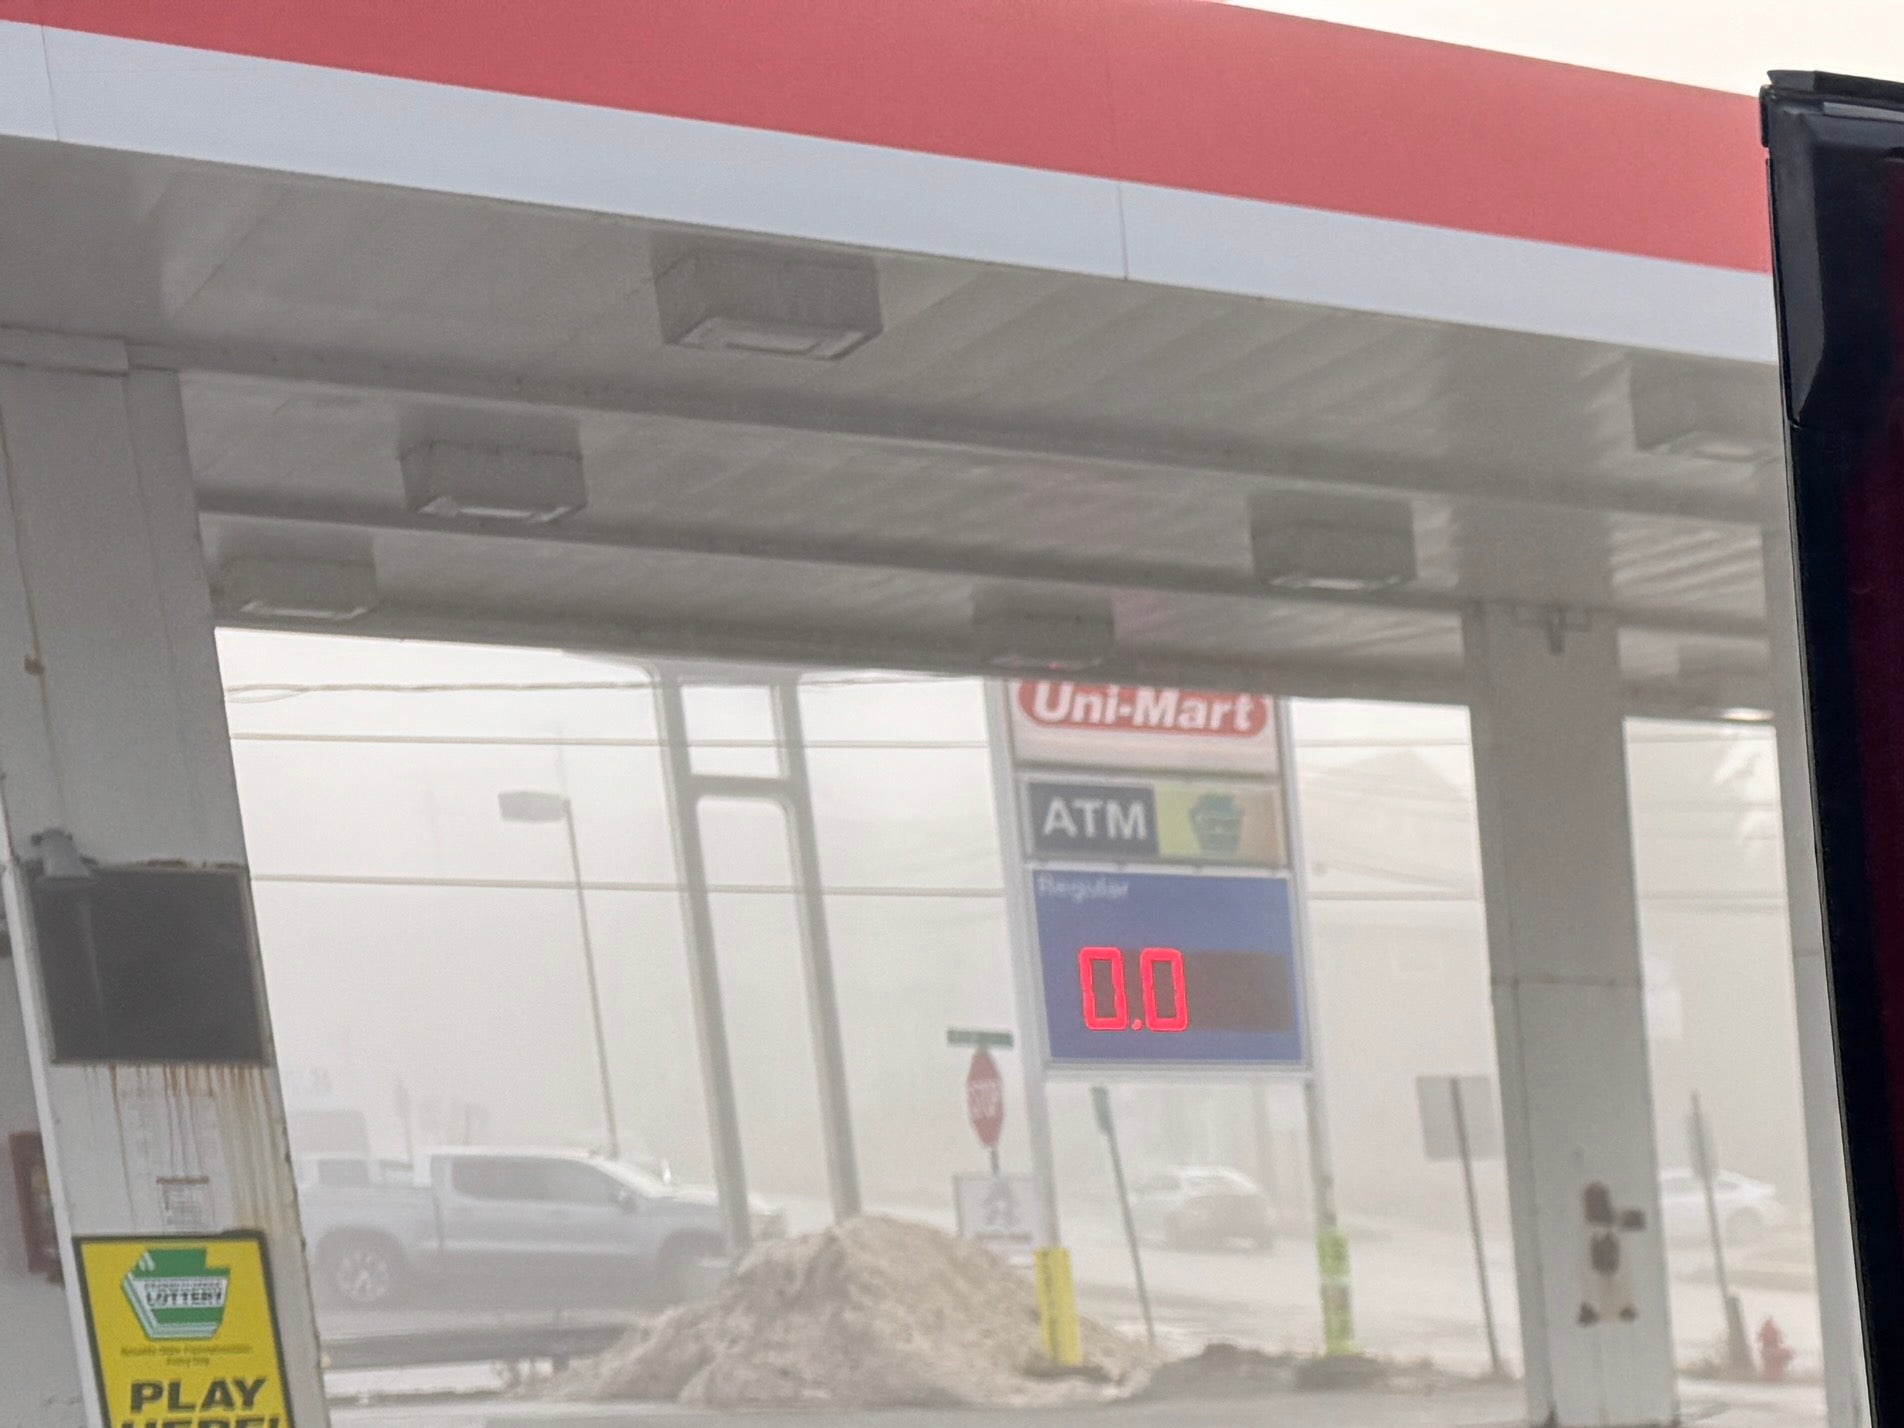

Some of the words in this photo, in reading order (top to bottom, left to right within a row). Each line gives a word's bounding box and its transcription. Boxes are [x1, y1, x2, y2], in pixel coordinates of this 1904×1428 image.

[1032, 681, 1254, 731] Uni-Mart
[1042, 797, 1148, 841] ATM
[1037, 873, 1130, 903] Regular
[130, 1376, 268, 1414] PLAY
